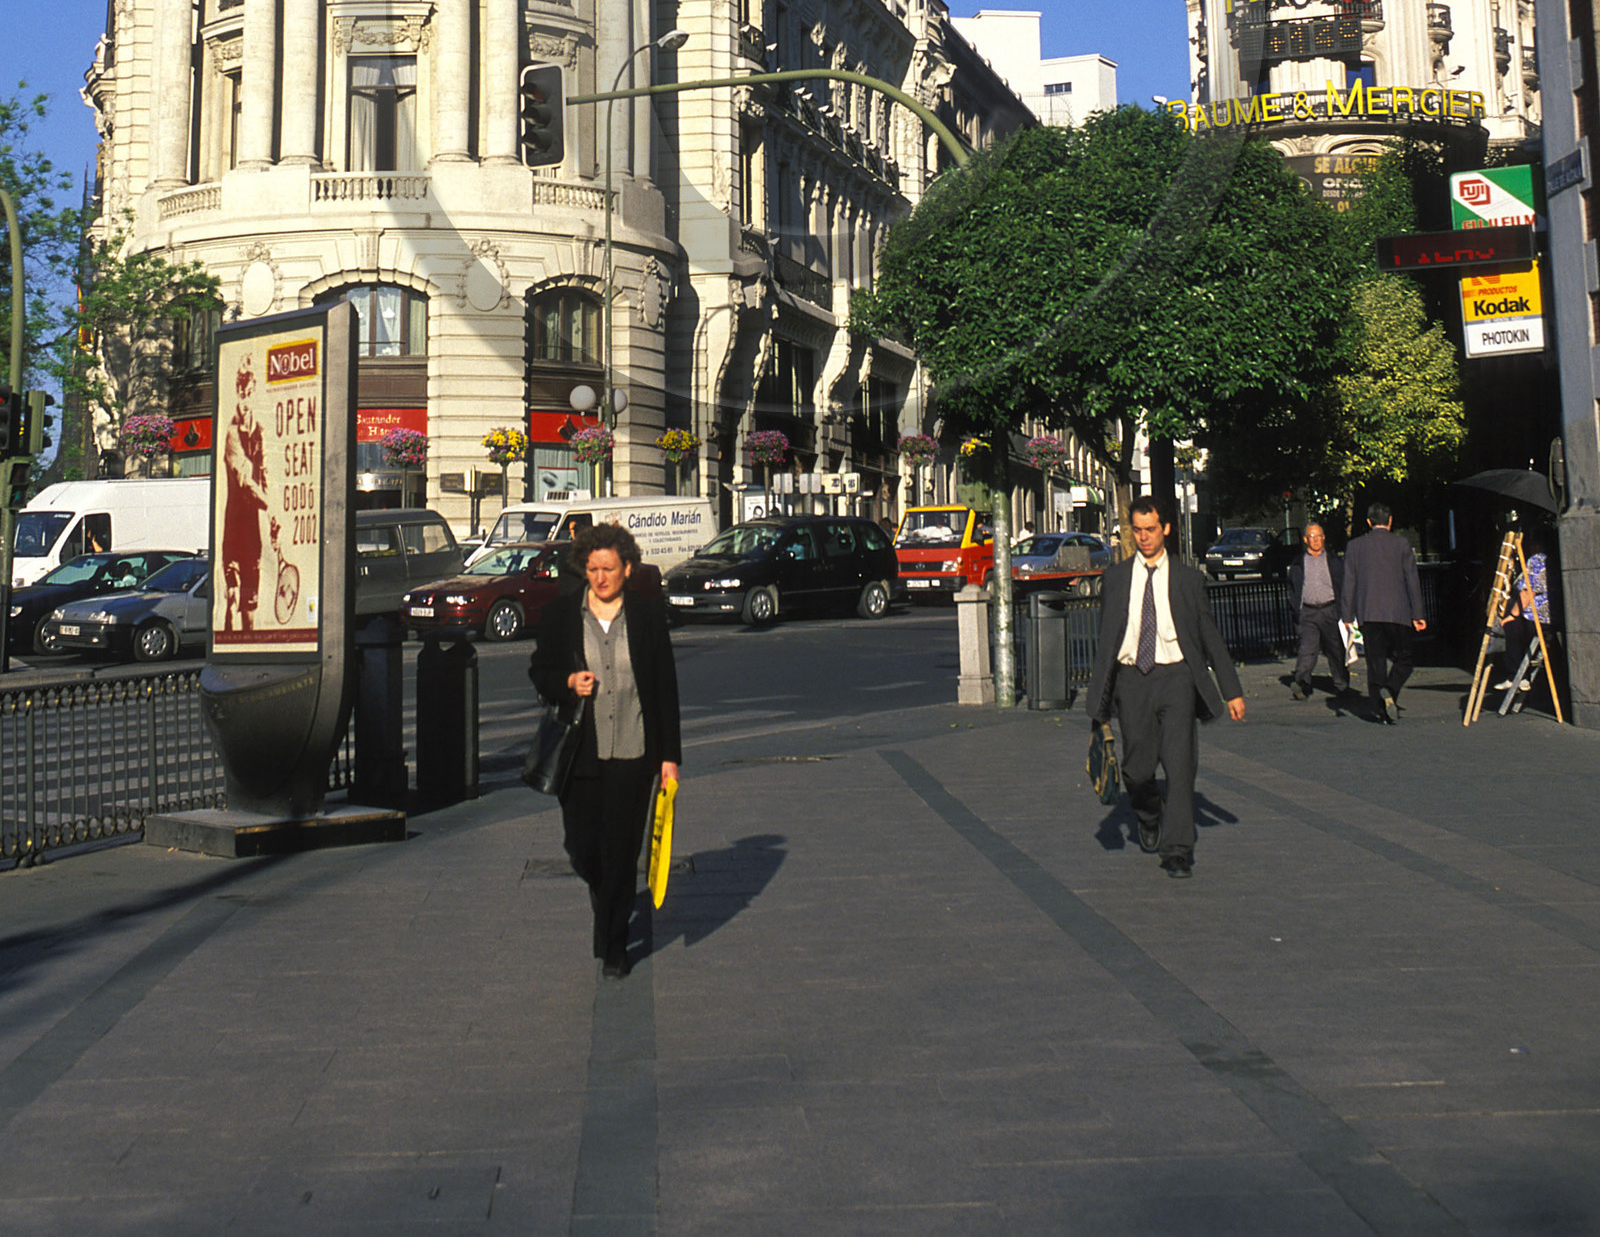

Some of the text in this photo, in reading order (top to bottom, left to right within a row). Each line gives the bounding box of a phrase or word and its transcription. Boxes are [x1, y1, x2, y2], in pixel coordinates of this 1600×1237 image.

[1168, 78, 1487, 133] BAUME & MERCIER
[1313, 157, 1331, 174] SE
[1459, 179, 1492, 207] FUJI
[1478, 286, 1518, 296] PRODUCTOS
[1473, 296, 1531, 316] Kodak
[1482, 329, 1530, 346] PHOTOKIN
[270, 347, 315, 375] Nobel
[276, 396, 316, 438] OPEN
[284, 441, 315, 477] SEAT
[292, 513, 317, 545] 2002
[628, 507, 701, 529] Cándido Marián
